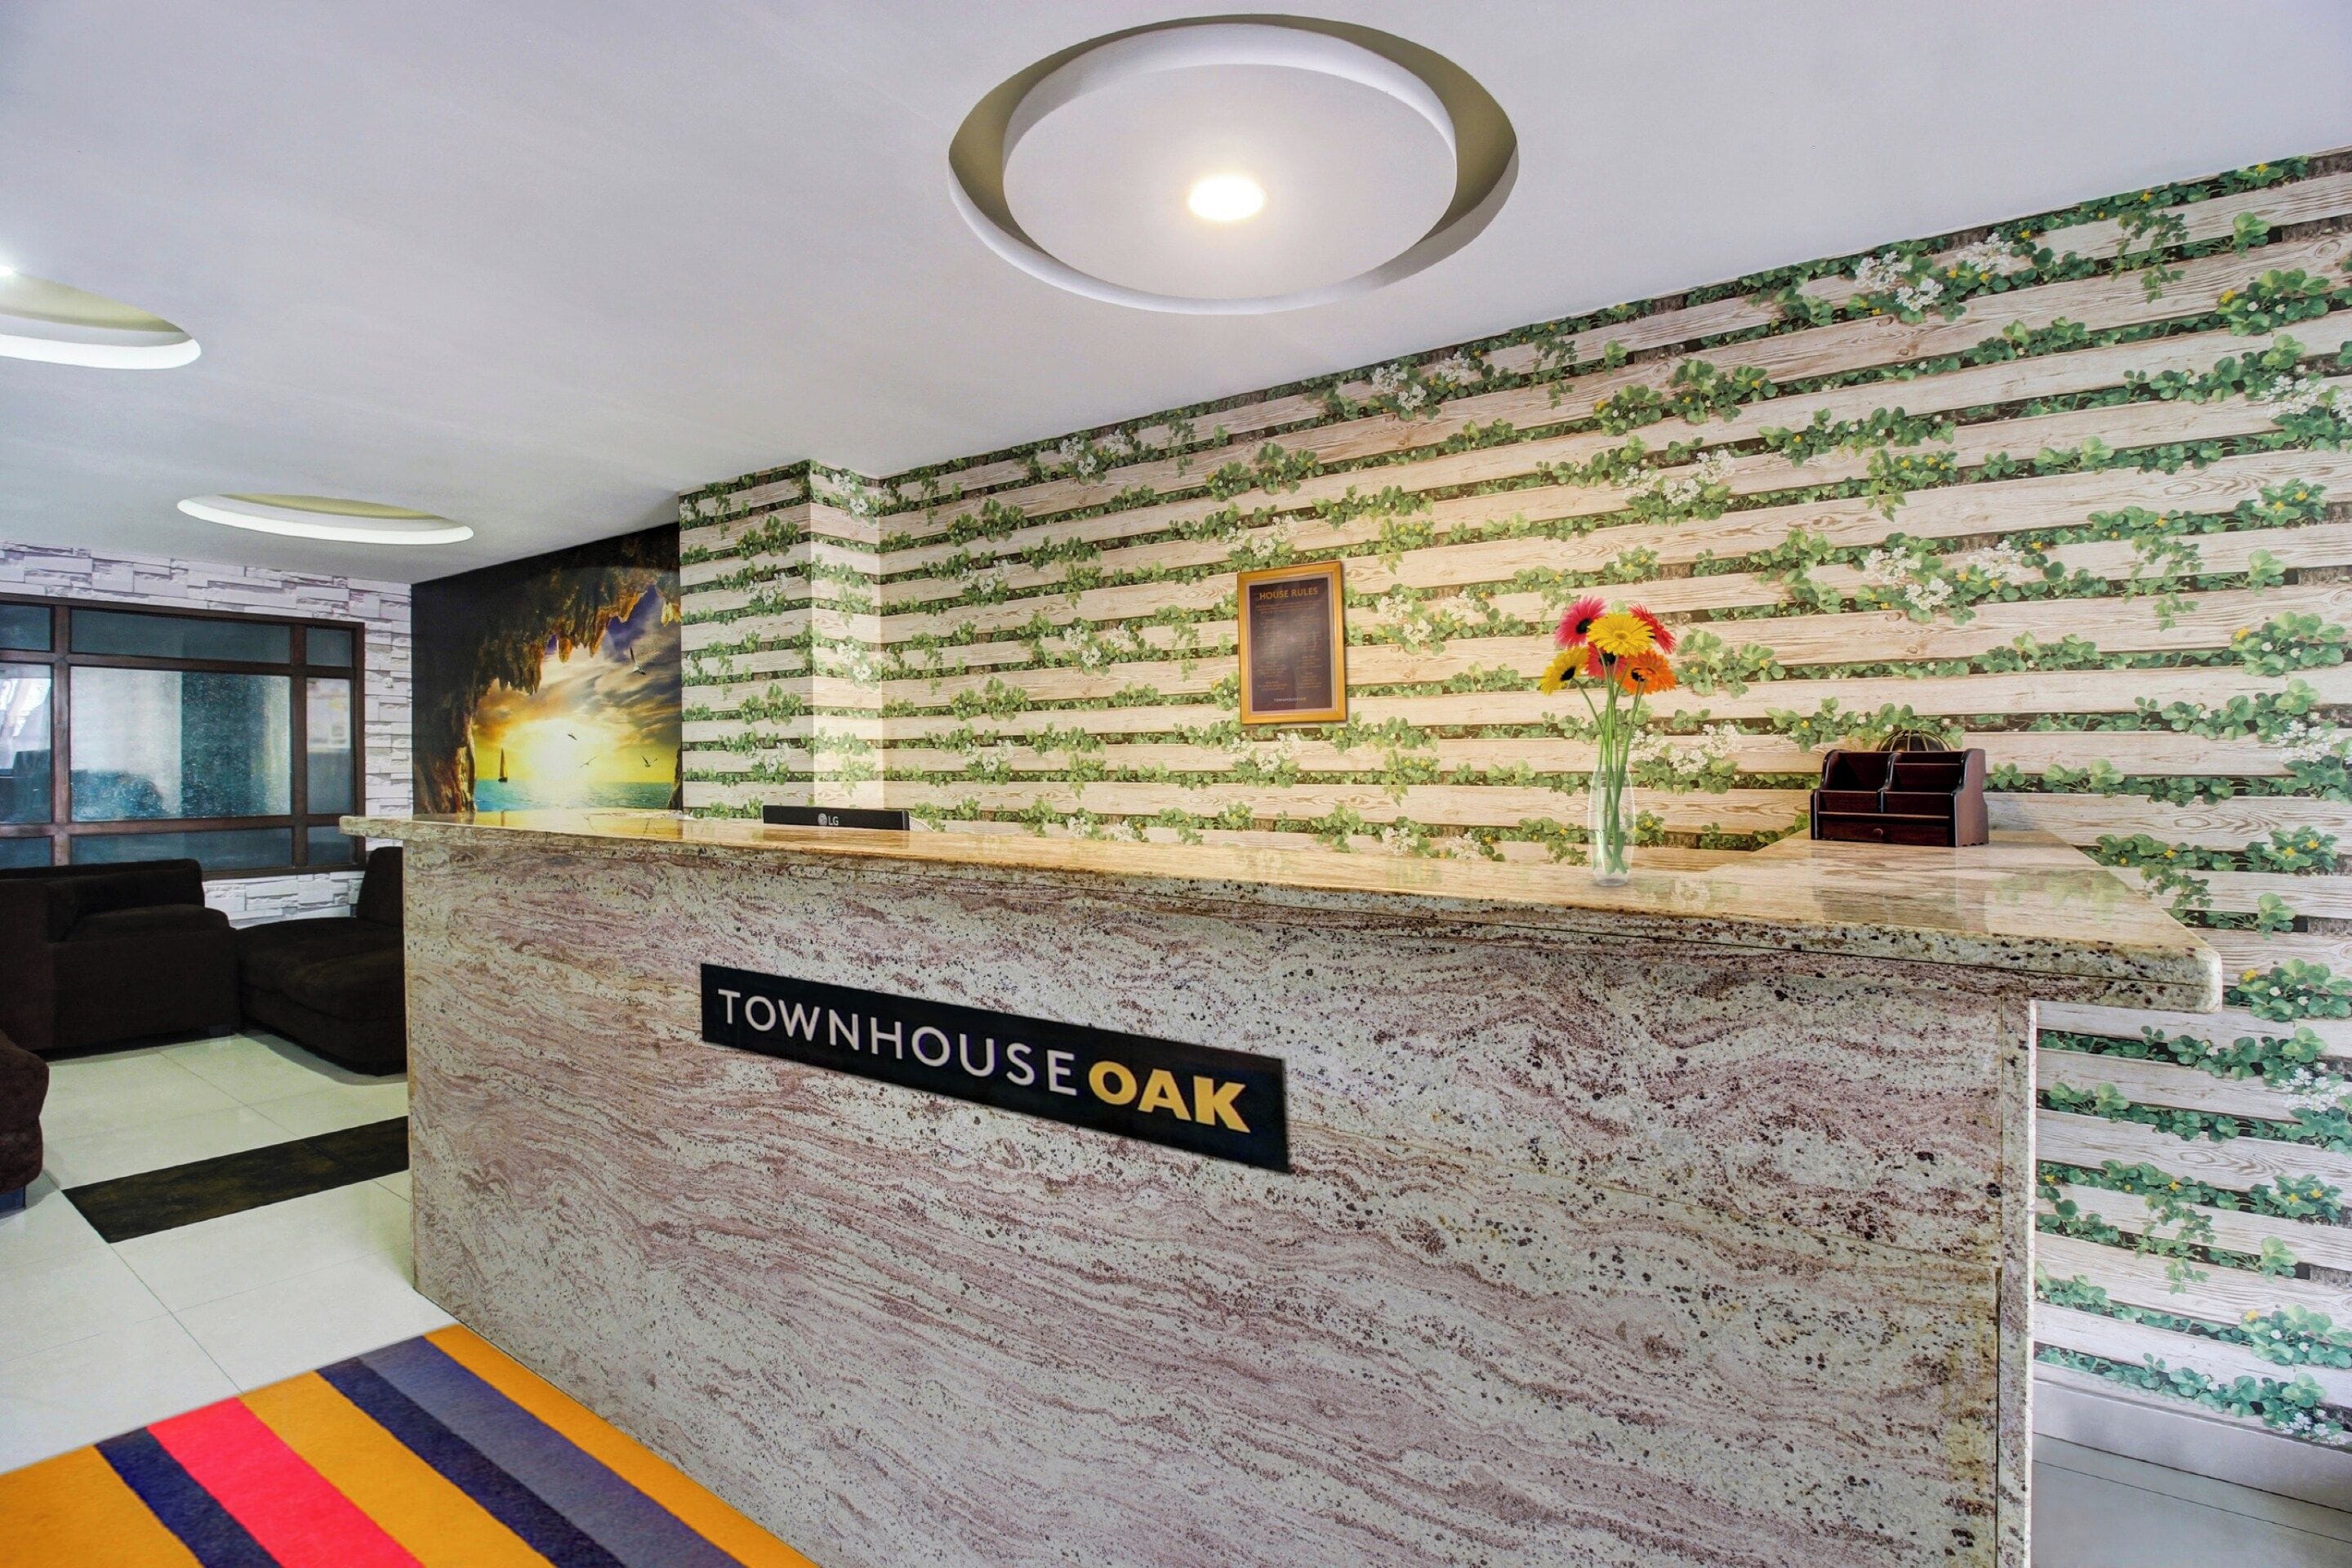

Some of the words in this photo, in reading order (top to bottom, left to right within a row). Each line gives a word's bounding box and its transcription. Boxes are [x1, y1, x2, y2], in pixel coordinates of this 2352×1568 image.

[1259, 590, 1289, 600] HOUSE
[1291, 587, 1318, 597] RULES
[828, 816, 839, 826] LG
[718, 989, 1077, 1096] TOWNHOUSE
[1089, 1061, 1251, 1134] OAK
